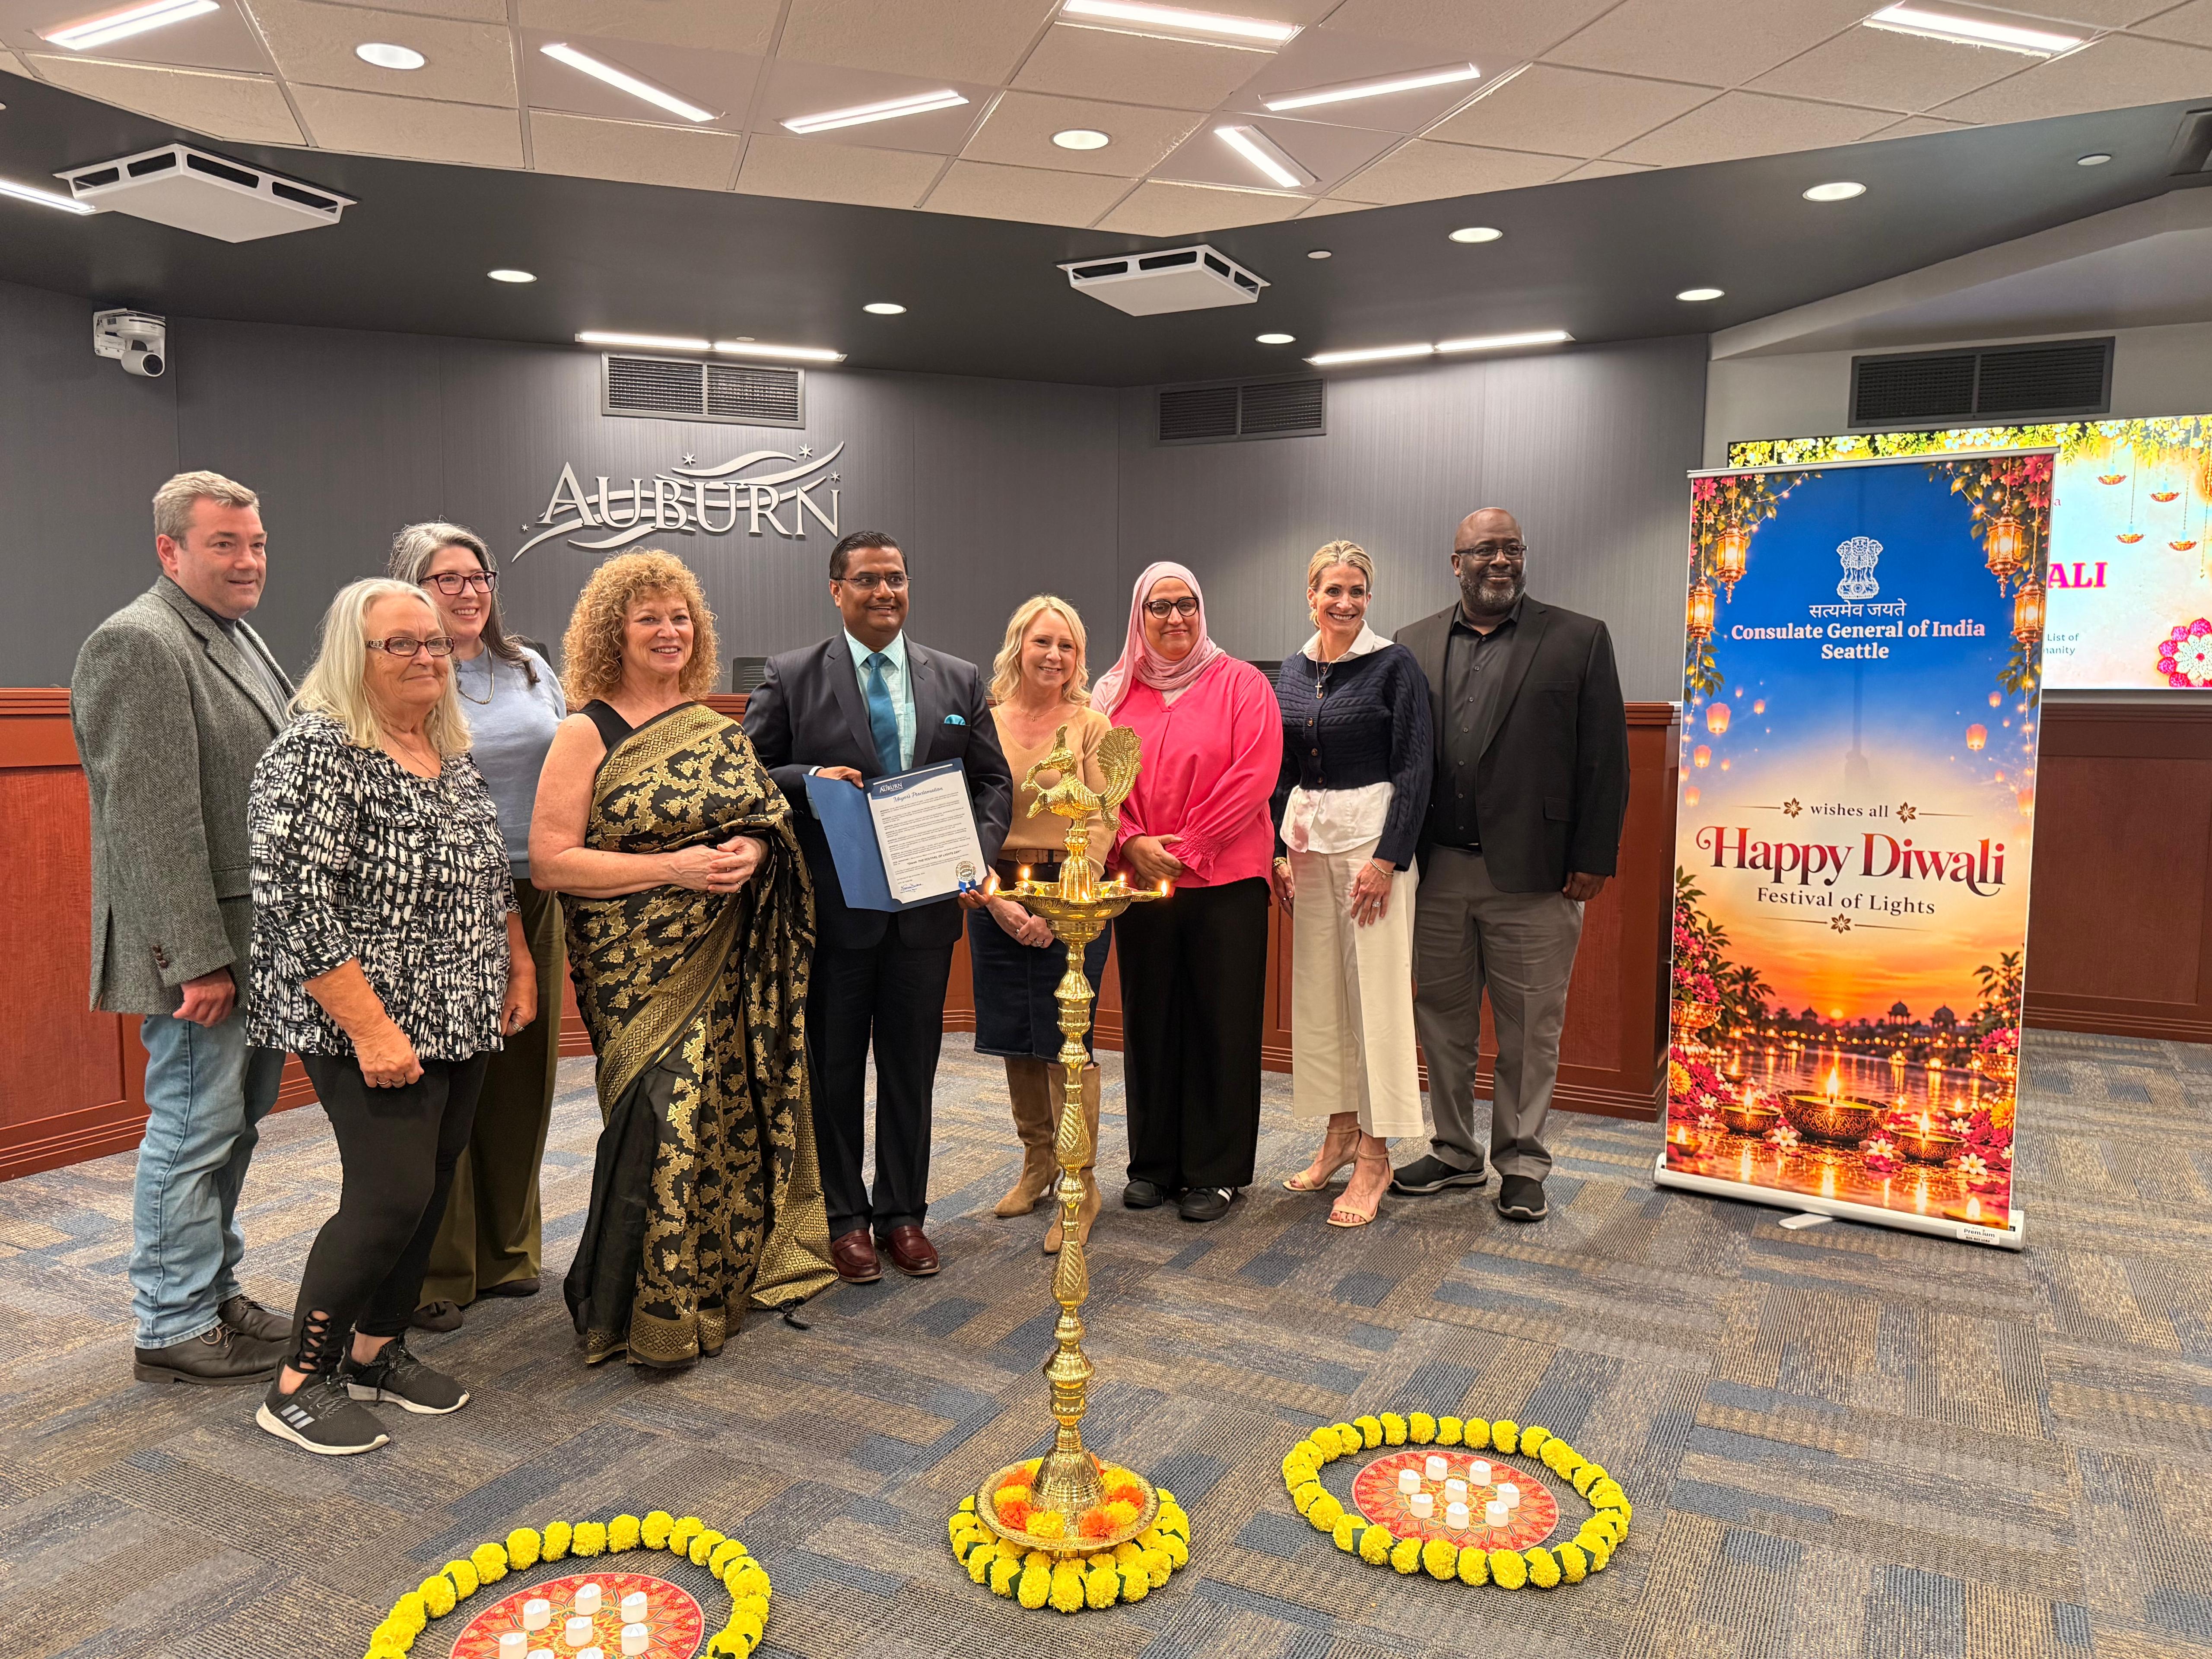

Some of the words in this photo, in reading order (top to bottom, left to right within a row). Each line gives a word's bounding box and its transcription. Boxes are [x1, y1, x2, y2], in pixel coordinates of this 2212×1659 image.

[535, 461, 840, 537] AUBURN
[1808, 600, 1863, 618] सत्यमेव
[1867, 598, 1907, 617] जयते
[1731, 622, 1823, 640] Consulate
[1827, 620, 1903, 639] General
[1907, 619, 1930, 637] of
[1932, 619, 1985, 637] India
[2047, 633, 2065, 641] List
[2068, 633, 2079, 641] of
[1821, 642, 1889, 659] Seattle
[912, 787, 943, 798] Proclamation
[1810, 803, 1863, 817] wishes
[1869, 804, 1888, 818] all
[1696, 826, 1854, 886] Happy
[1859, 832, 2006, 897] Diwali
[1757, 887, 1833, 908] Festival
[1841, 893, 1862, 909] of
[1869, 895, 1936, 916] Lights
